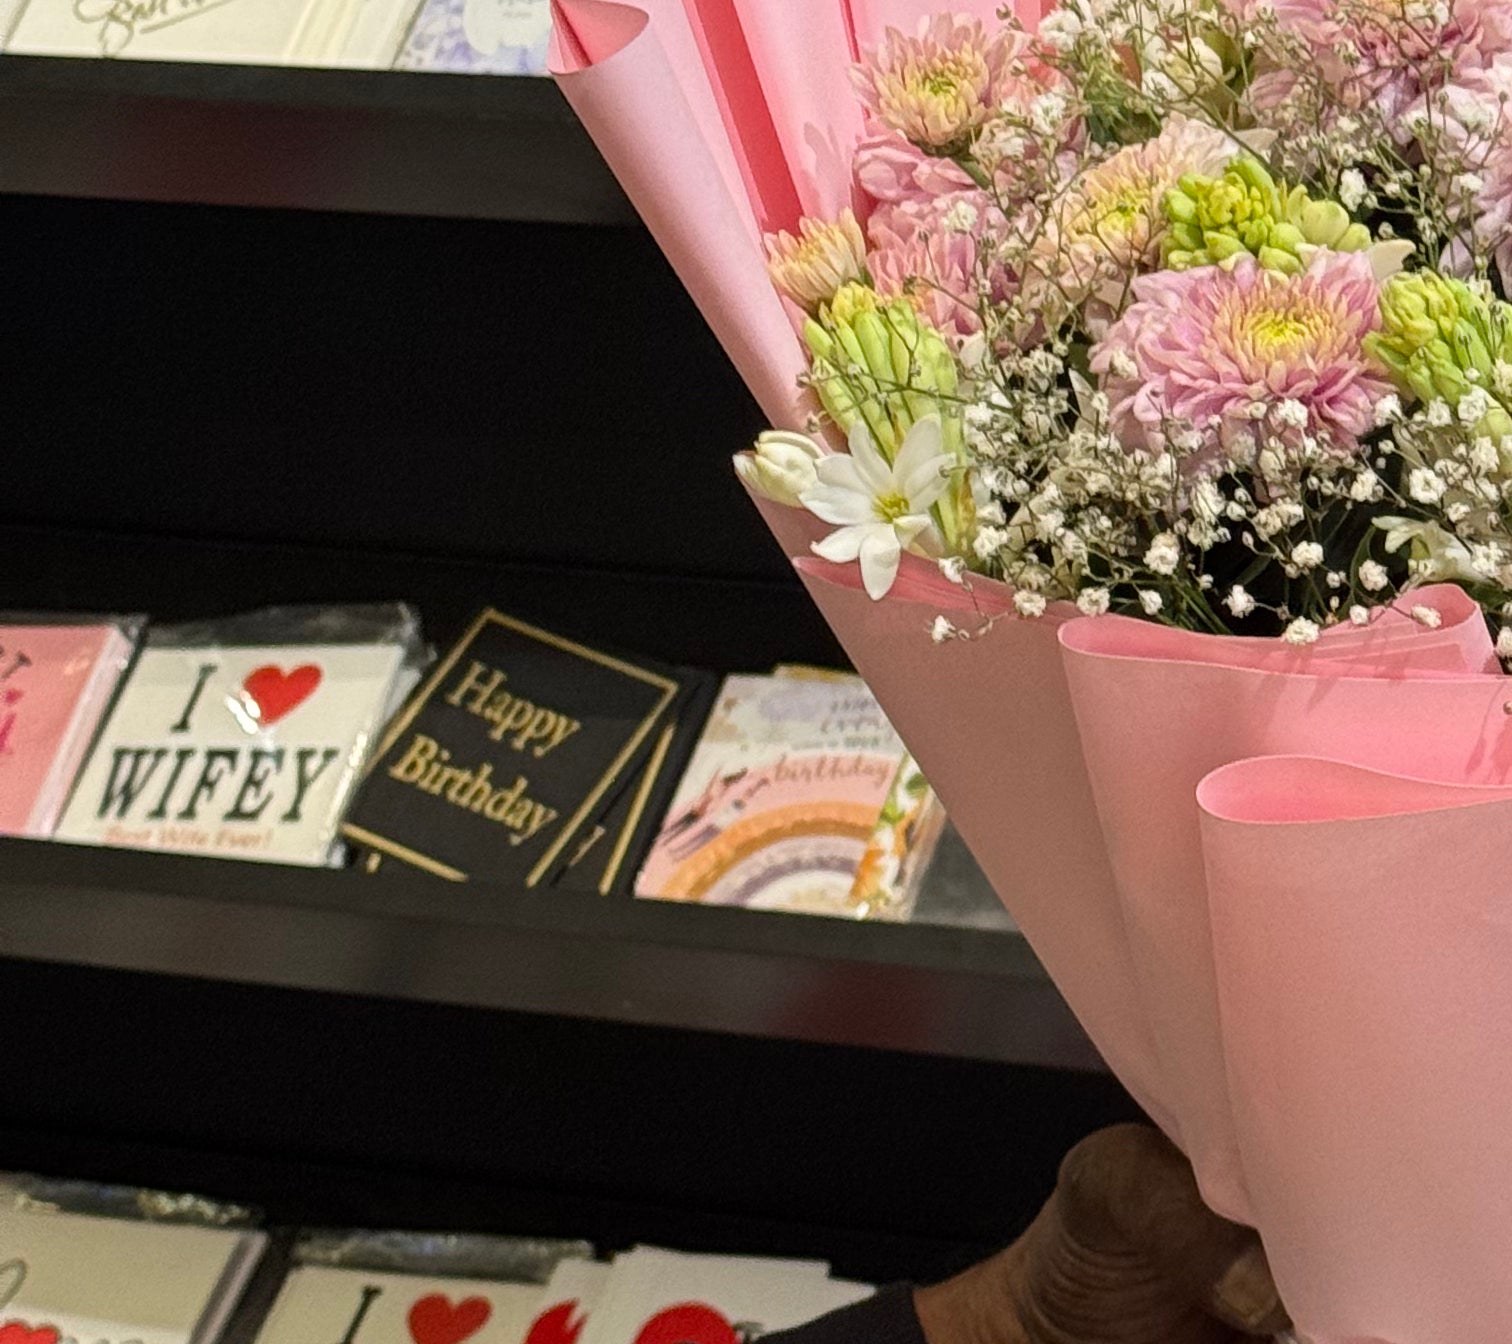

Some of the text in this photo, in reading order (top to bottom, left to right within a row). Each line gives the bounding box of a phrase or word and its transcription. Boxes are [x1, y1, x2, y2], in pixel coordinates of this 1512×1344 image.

[171, 664, 217, 734] I
[445, 662, 581, 757] Happy
[97, 746, 339, 824] WIFEY
[389, 734, 559, 846] Birthday
